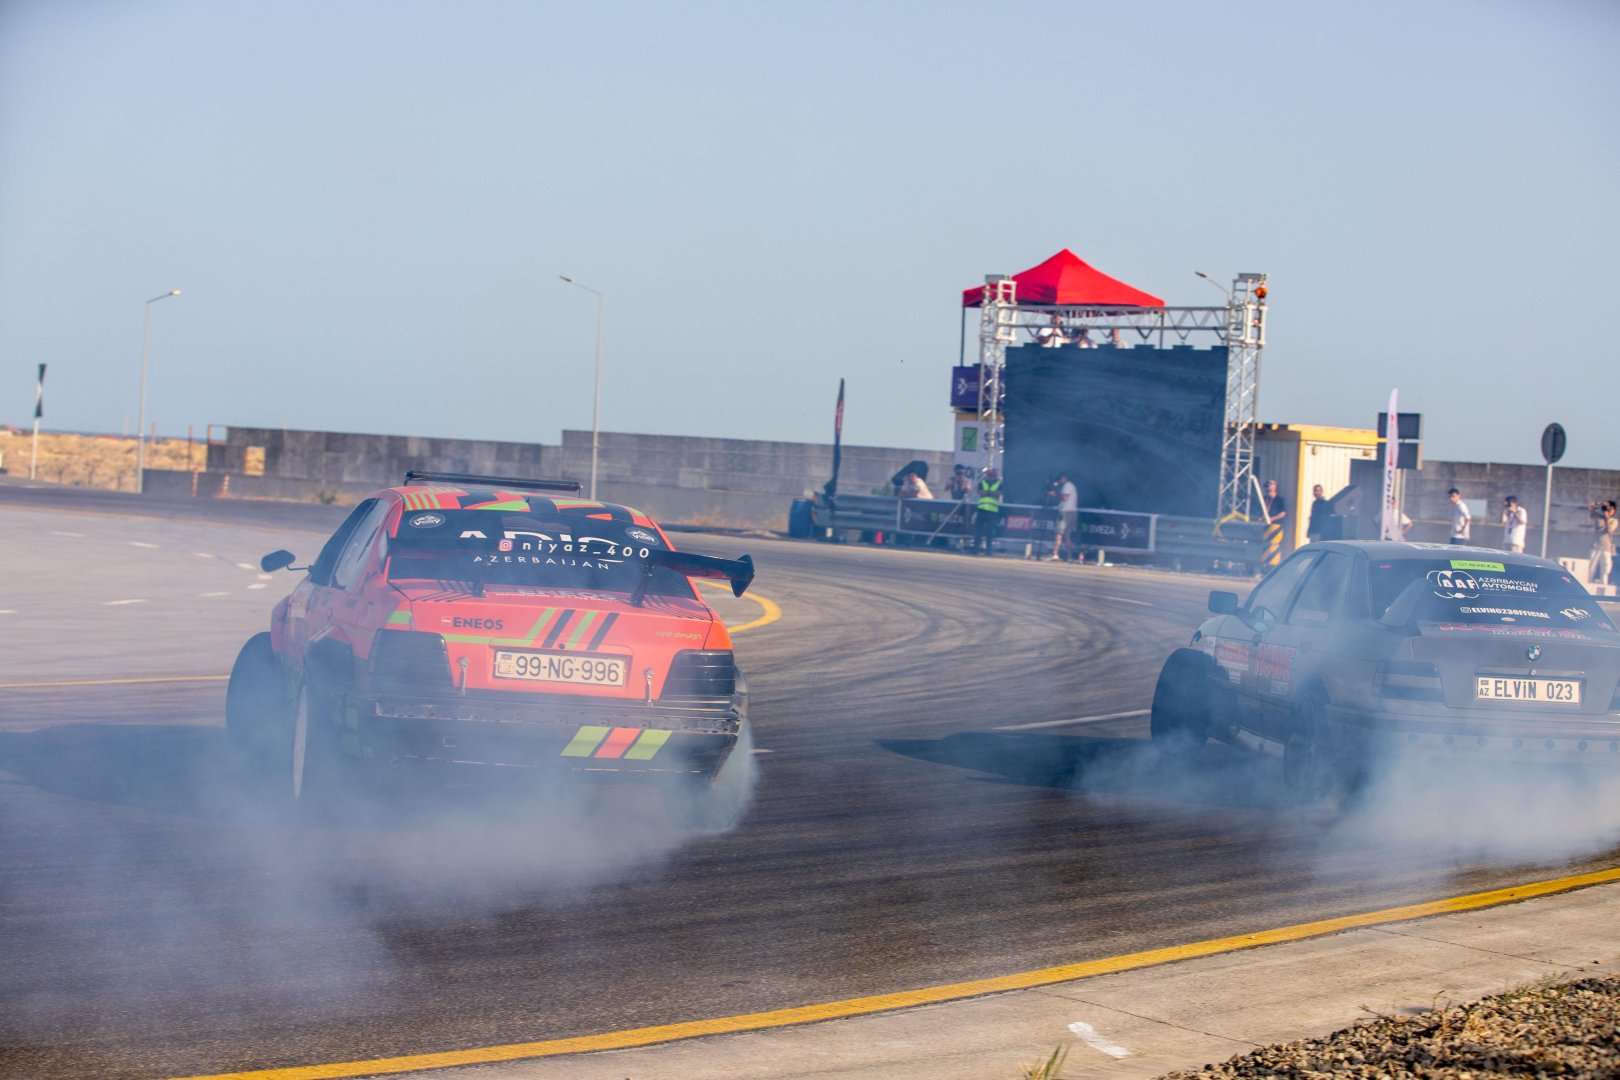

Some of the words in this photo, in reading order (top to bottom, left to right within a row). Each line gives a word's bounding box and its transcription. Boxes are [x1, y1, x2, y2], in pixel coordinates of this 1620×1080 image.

[522, 540, 650, 559] niyaz_400
[473, 555, 609, 570] AZERBAIJAN
[452, 616, 504, 630] ENEOS
[515, 655, 620, 682] 99-NG-996
[1479, 687, 1490, 697] AZ
[1546, 682, 1573, 700] 023
